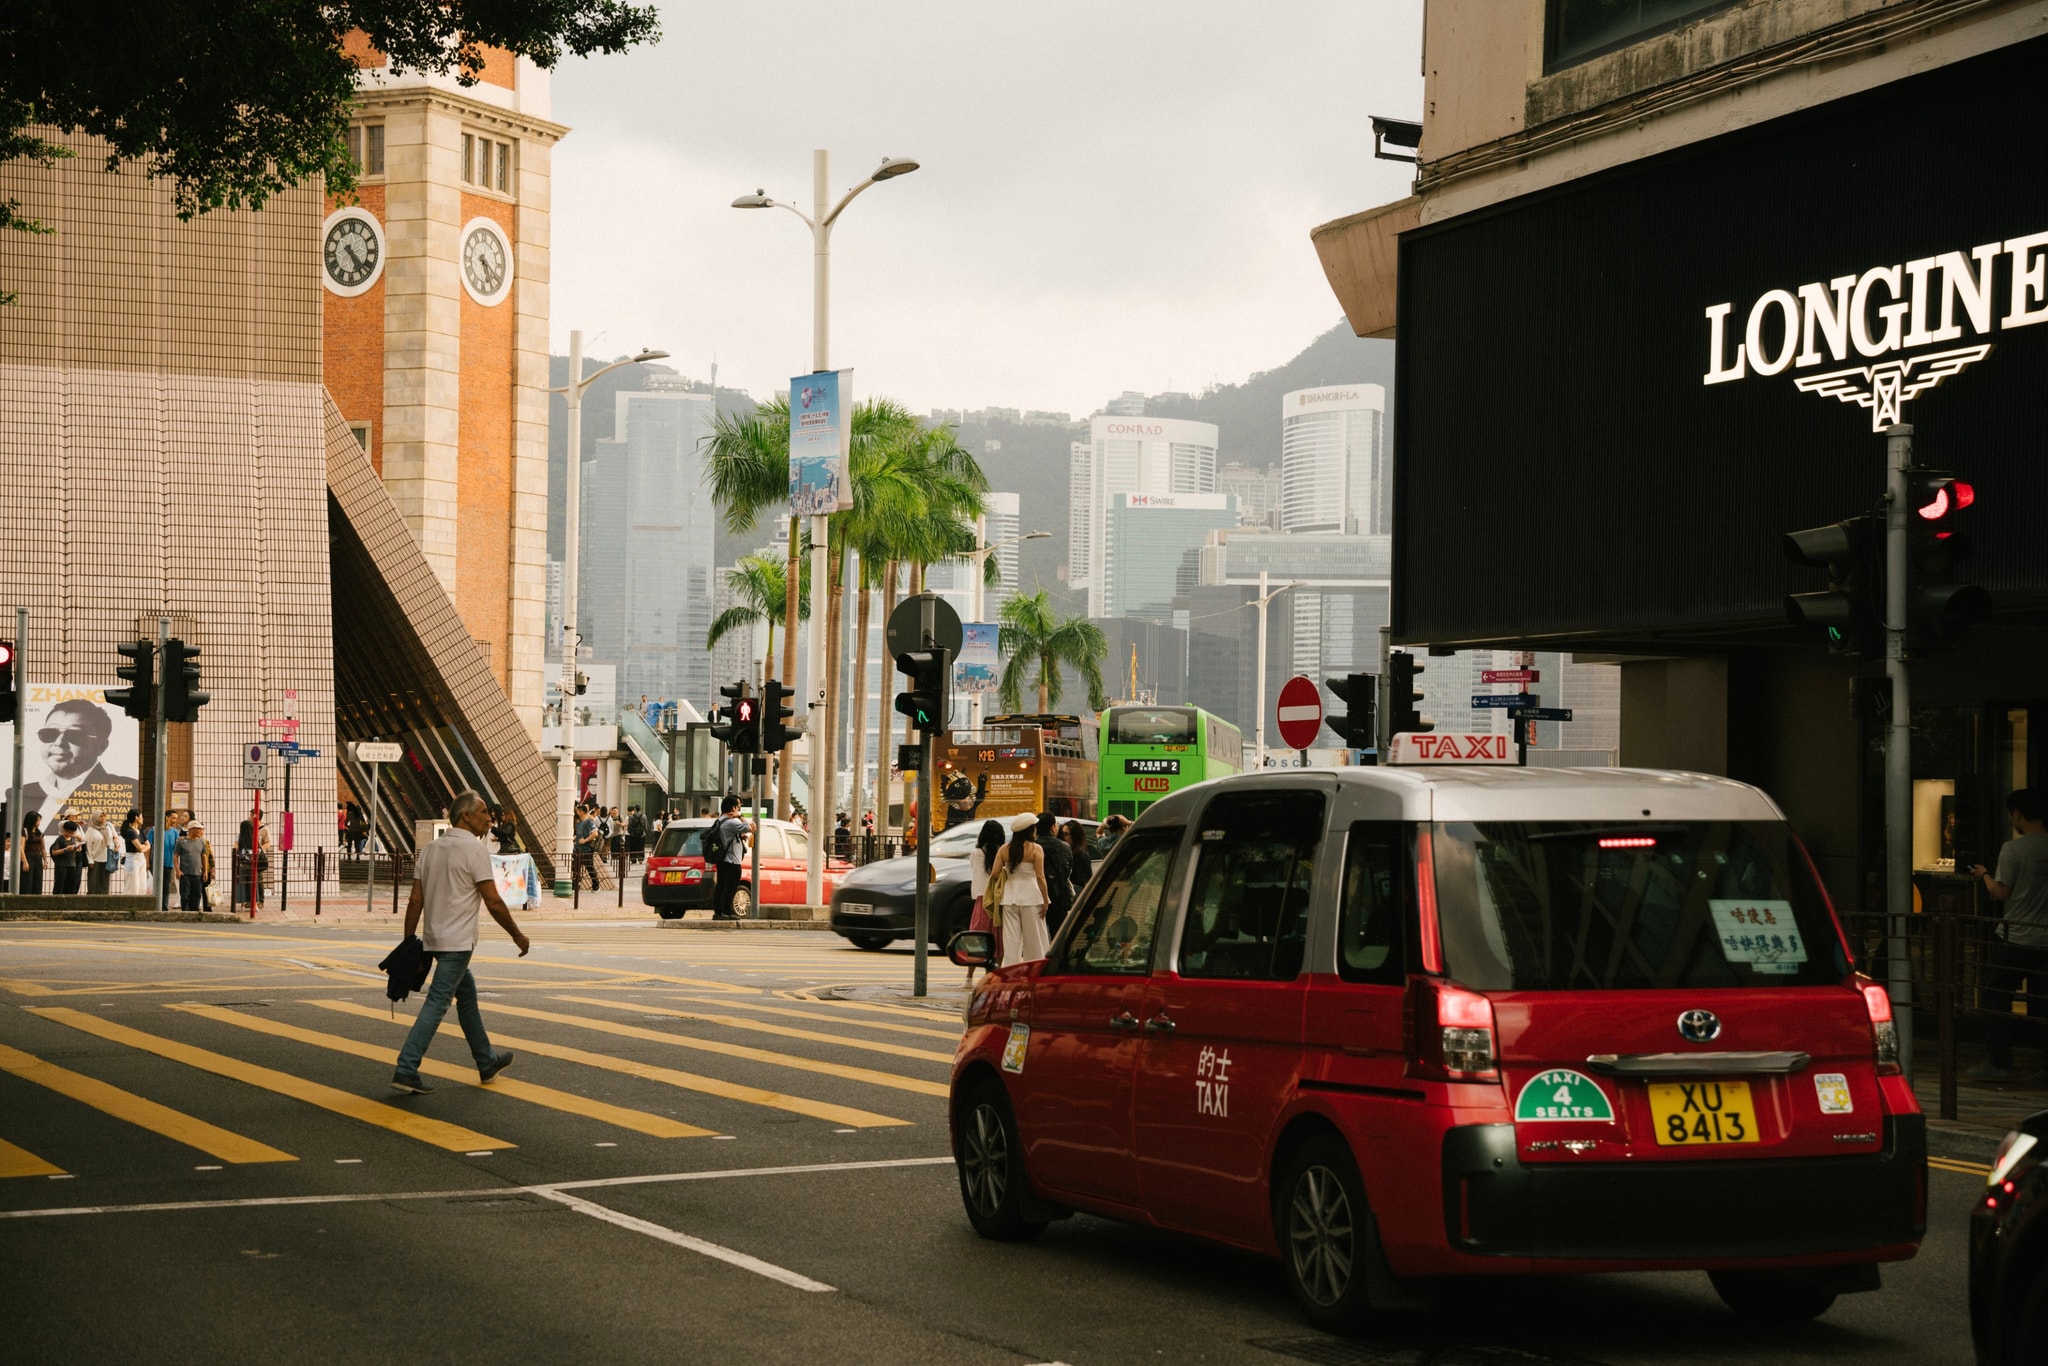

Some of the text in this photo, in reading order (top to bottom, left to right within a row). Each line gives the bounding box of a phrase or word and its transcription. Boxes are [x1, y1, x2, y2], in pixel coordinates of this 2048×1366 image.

[1307, 391, 1359, 403] SHANGRI-LA
[1107, 424, 1163, 435] CONRAD
[31, 687, 106, 703] ZHANG
[1411, 735, 1507, 759] TAXI
[978, 750, 995, 761] KMB
[258, 766, 263, 774] 7
[1171, 761, 1178, 771] 2
[1134, 777, 1170, 791] KMB
[1197, 1045, 1233, 1082] 的士
[1541, 1072, 1580, 1086] TAXI
[1195, 1080, 1229, 1118] TAXI
[1552, 1085, 1573, 1106] 4
[1679, 1083, 1723, 1113] XU
[1535, 1106, 1594, 1118] SEATS
[1667, 1112, 1745, 1143] 8413
